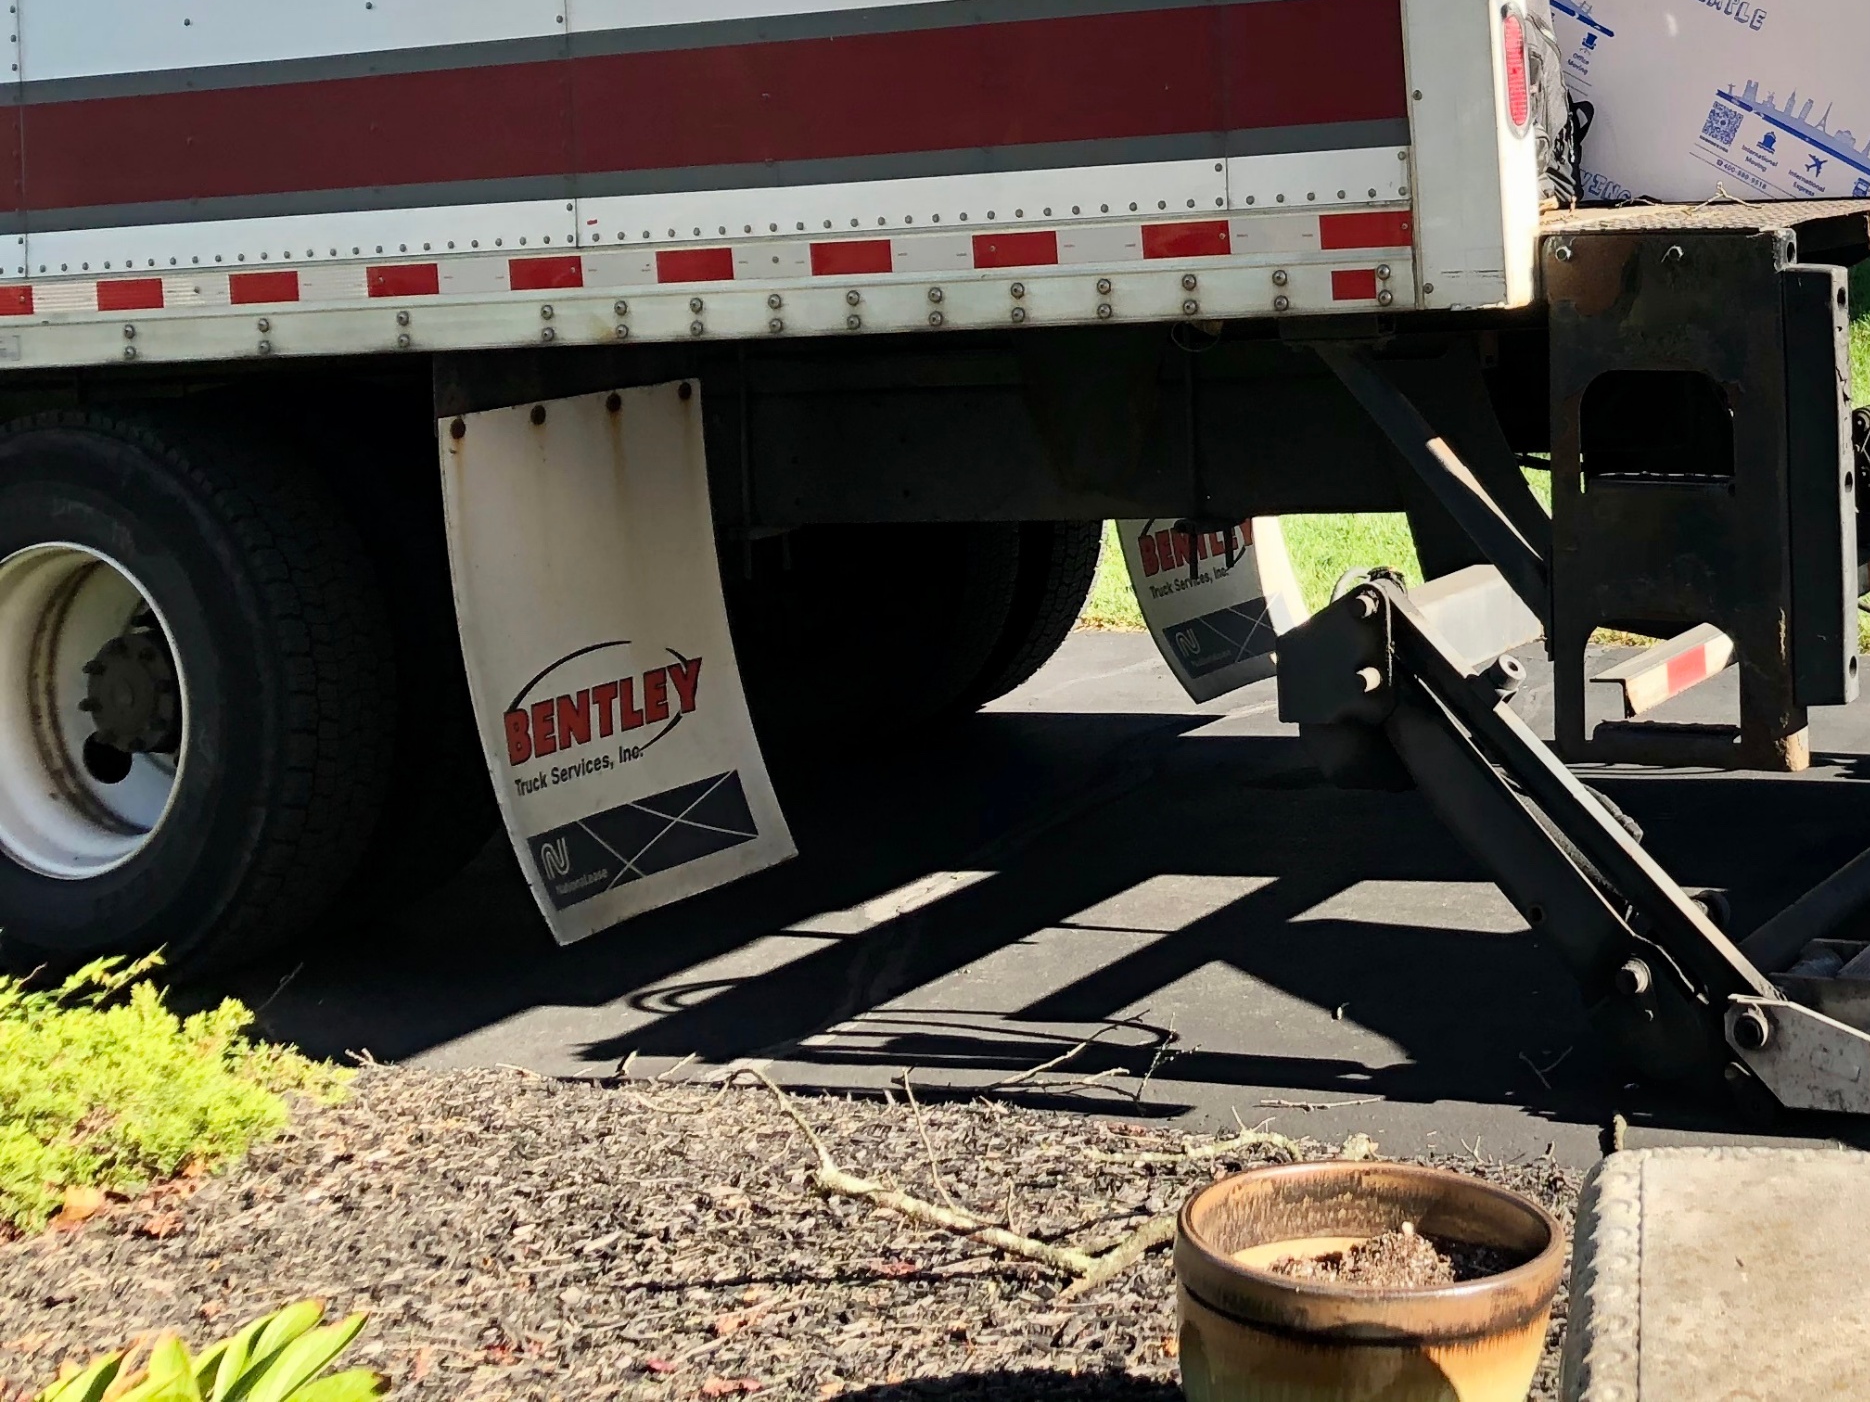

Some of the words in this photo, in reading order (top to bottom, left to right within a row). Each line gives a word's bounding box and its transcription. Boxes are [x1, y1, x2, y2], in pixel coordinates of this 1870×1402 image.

[1566, 59, 1588, 76] Moving
[1571, 51, 1590, 66] Office
[1742, 144, 1778, 167] International
[1745, 156, 1767, 172] Moving
[1788, 169, 1826, 192] International
[1792, 181, 1815, 196] Express
[1149, 581, 1175, 599] Truck
[504, 657, 702, 766] BENTLEY
[515, 771, 547, 796] Truck
[551, 752, 614, 785] Services,
[618, 745, 644, 764] Inc.
